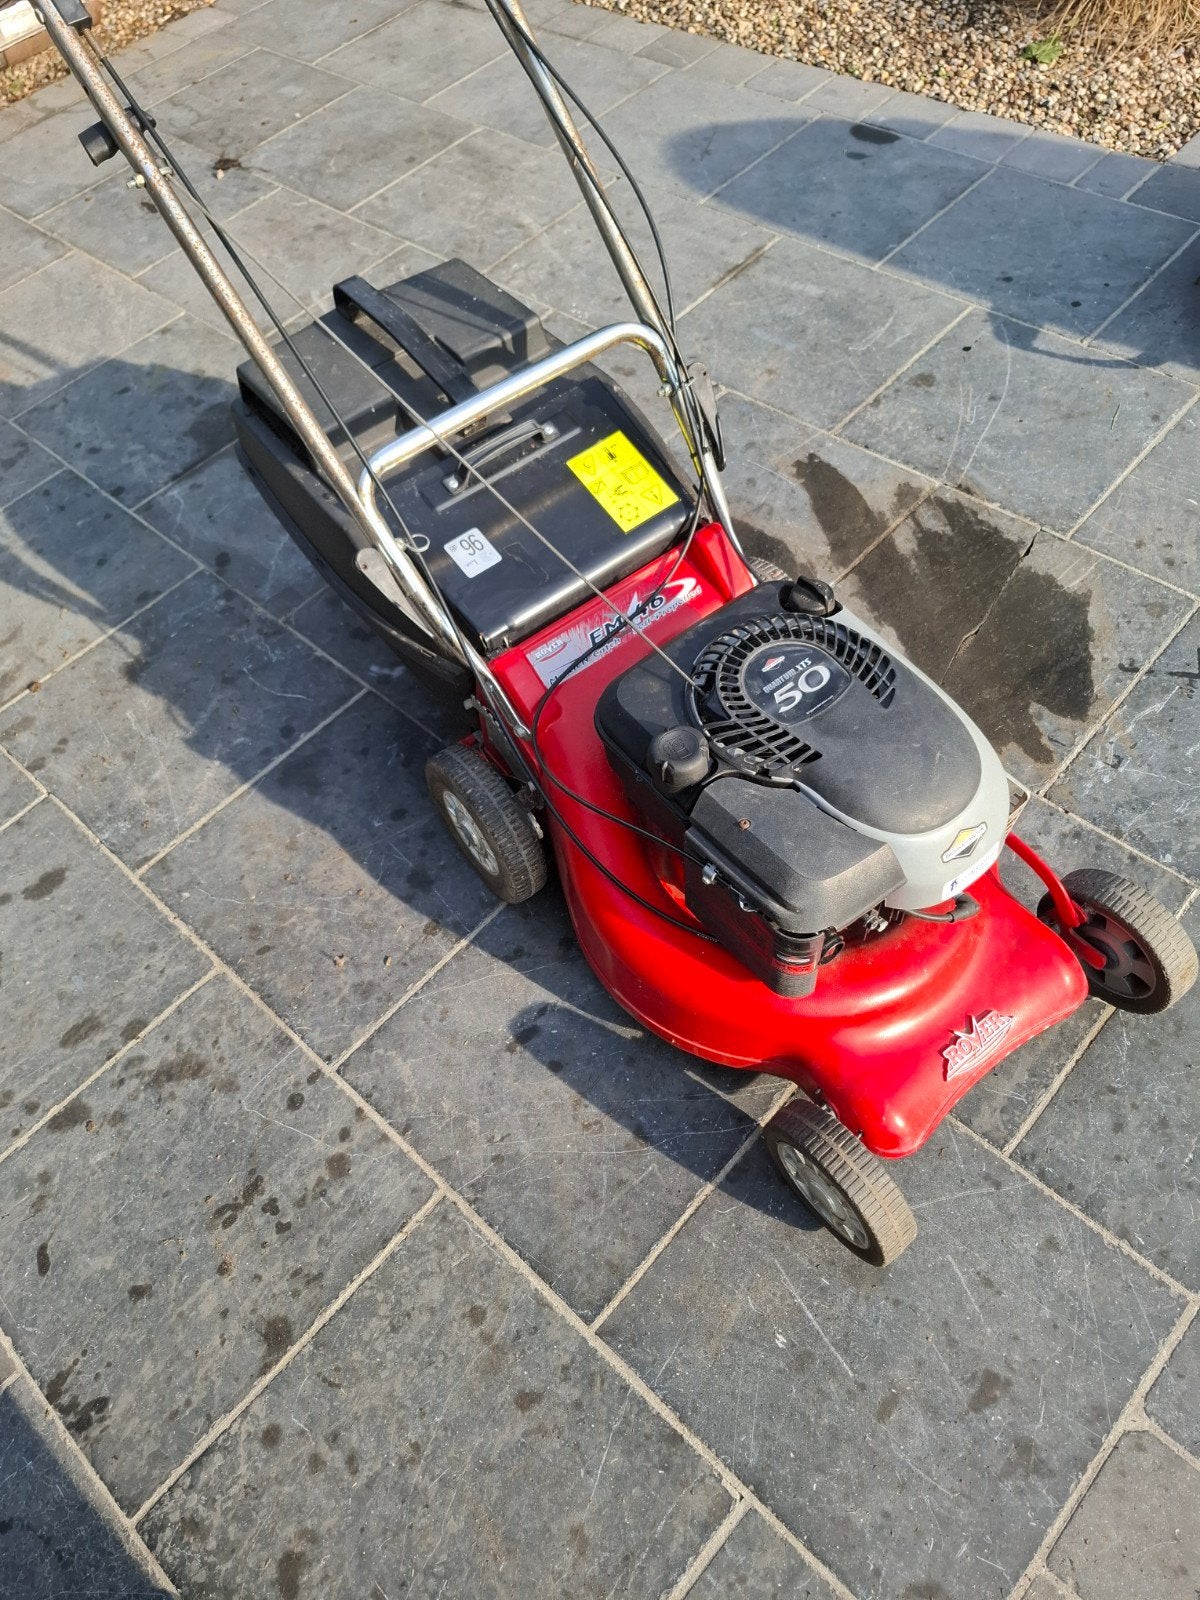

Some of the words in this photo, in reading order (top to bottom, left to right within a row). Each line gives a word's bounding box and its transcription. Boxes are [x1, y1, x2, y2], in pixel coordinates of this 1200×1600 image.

[460, 534, 484, 556] 96
[534, 639, 564, 660] ROVER
[762, 668, 798, 694] QUANTUM
[795, 657, 812, 671] XTS
[773, 665, 831, 714] 50
[942, 1010, 1012, 1072] ROVER
